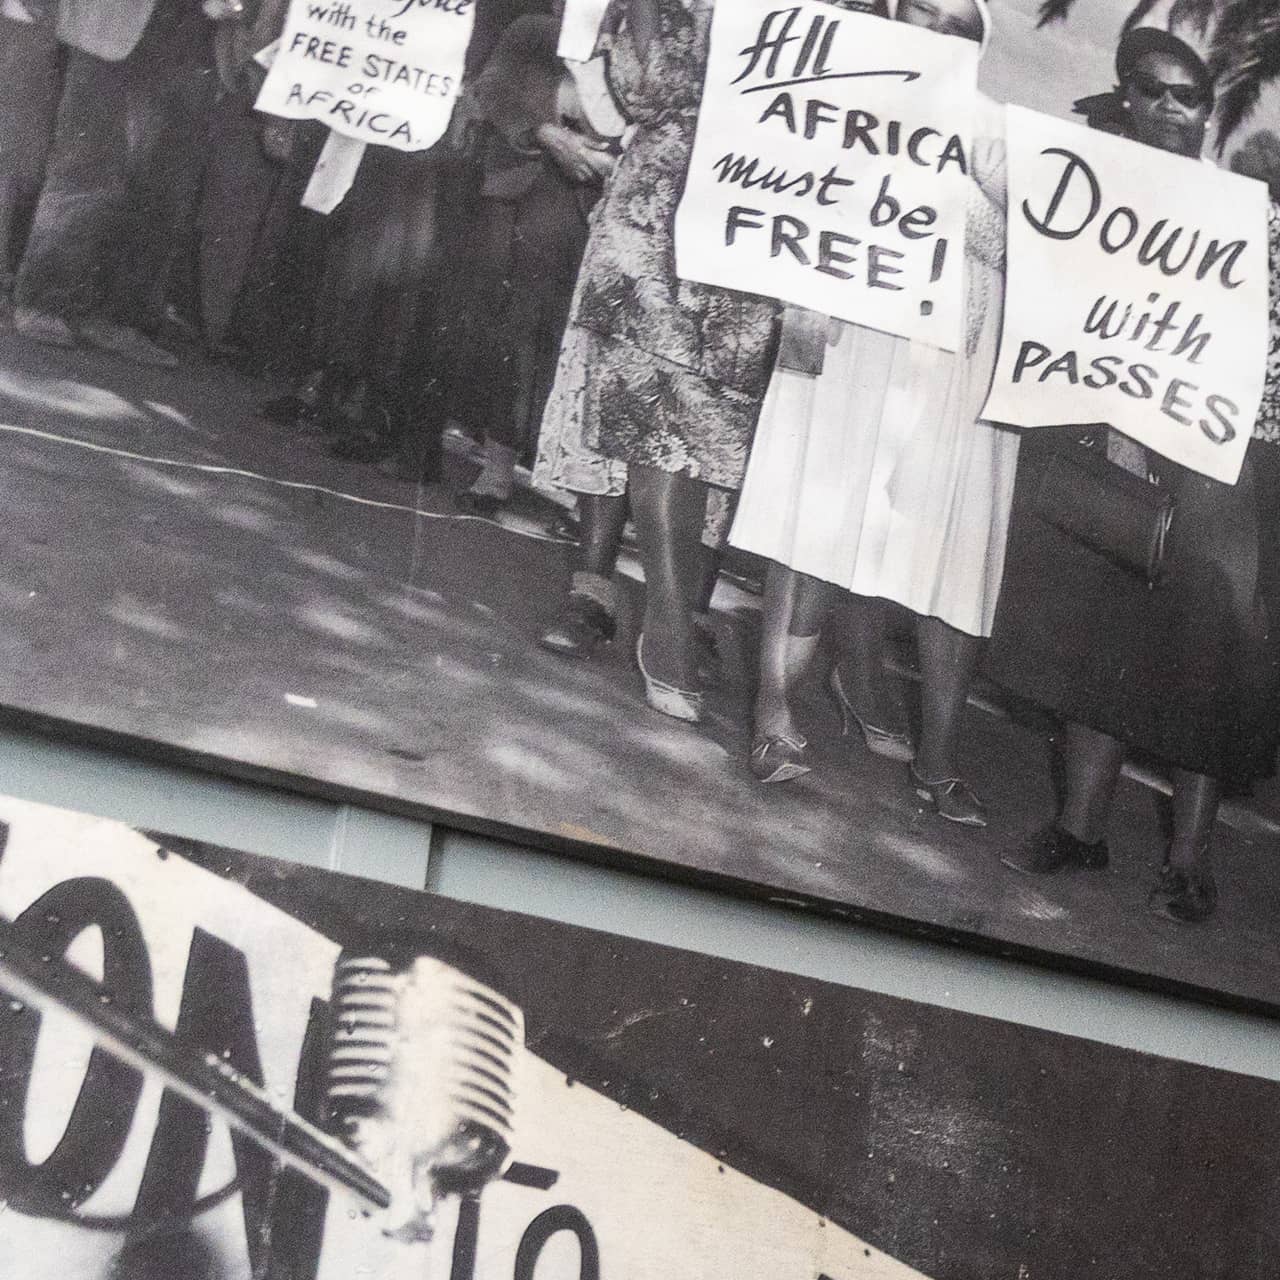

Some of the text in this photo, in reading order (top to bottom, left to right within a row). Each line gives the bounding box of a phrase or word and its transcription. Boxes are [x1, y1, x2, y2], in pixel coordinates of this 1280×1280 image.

[289, 32, 453, 98] FREE STATES
[307, 3, 408, 46] with the
[759, 92, 968, 176] AFRICA
[711, 150, 938, 241] must be
[1022, 147, 1248, 290] Down
[1082, 292, 1213, 366] with
[1012, 340, 1241, 446] PASSES
